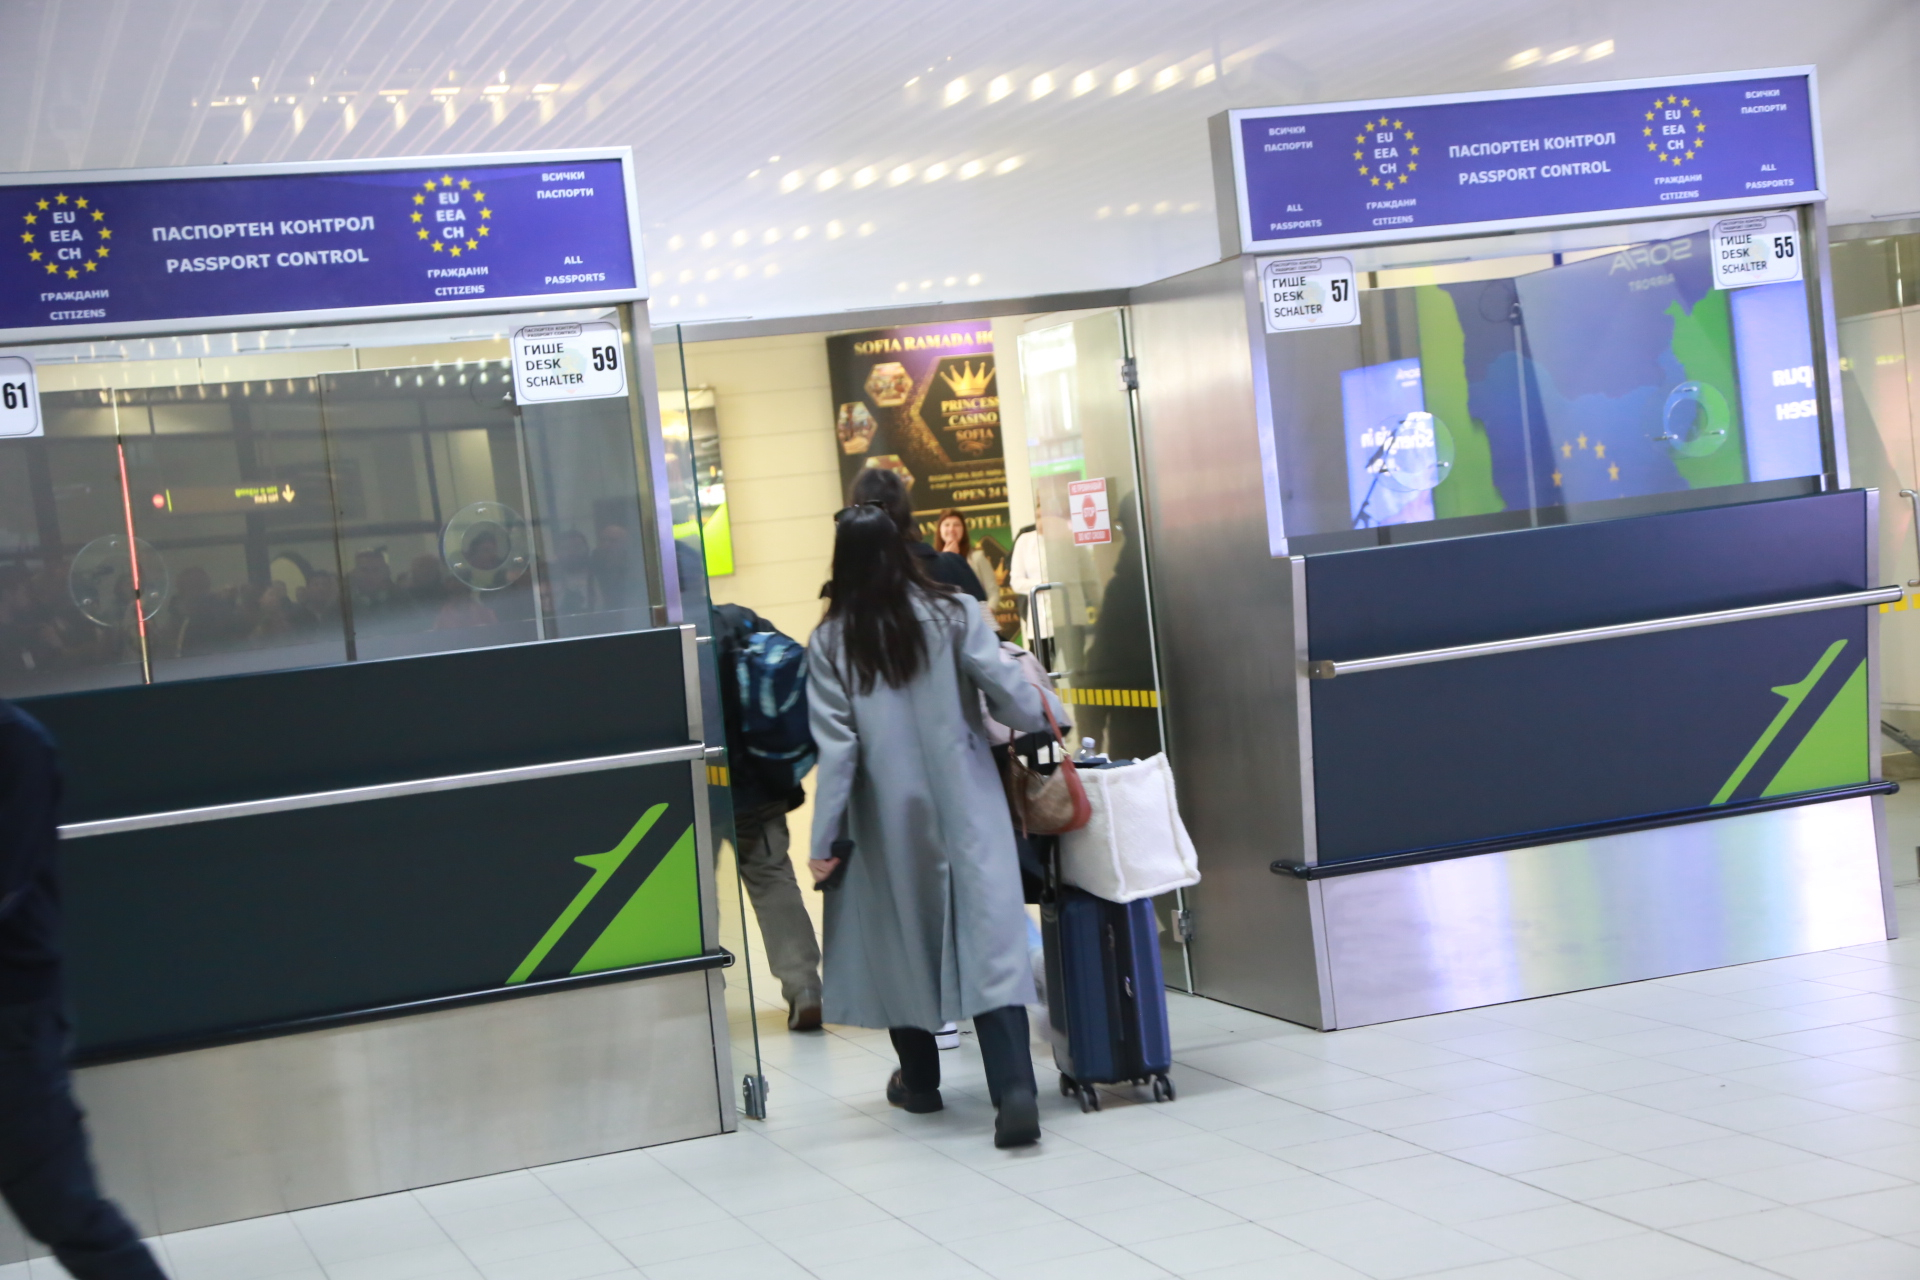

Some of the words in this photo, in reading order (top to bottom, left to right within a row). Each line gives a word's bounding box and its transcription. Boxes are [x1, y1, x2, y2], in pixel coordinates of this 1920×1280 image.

[1745, 89, 1780, 99] ВСИЧКИ
[1665, 110, 1681, 120] EU
[1741, 104, 1787, 114] ПАСПОРТИ
[1268, 126, 1306, 136] ВСИЧКИ
[1662, 124, 1686, 135] EEA
[1376, 132, 1394, 143] EU
[1264, 141, 1313, 152] ПАСПОРТИ
[1449, 138, 1540, 158] ПАСПОРТЕН
[1543, 132, 1616, 150] КОНТРОЛ
[1667, 139, 1685, 150] CH
[1374, 147, 1398, 159] EEA
[1379, 163, 1397, 174] CH
[1459, 166, 1537, 185] PASSPORT
[1540, 161, 1611, 178] CONTROL
[1761, 163, 1777, 172] ALL
[541, 171, 585, 182] ВСИЧКИ
[1654, 174, 1703, 185] ГРАЖДАНИ
[1745, 178, 1794, 189] PASSPORTS
[439, 192, 460, 204] EU
[537, 188, 594, 199] ПАСПОРТИ
[1660, 190, 1699, 200] CITIZENS
[1286, 204, 1303, 213] ALL
[1366, 198, 1417, 210] ГРАЖДАНИ
[53, 211, 76, 224] EU
[436, 209, 466, 222] EEA
[1372, 215, 1414, 226] CITIZENS
[152, 221, 274, 241] ПАСПОРТЕН
[280, 216, 375, 235] КОНТРОЛ
[1270, 219, 1322, 231] PASSPORTS
[50, 229, 83, 242] EEA
[442, 226, 464, 239] CH
[1720, 234, 1752, 246] ГИШЕ
[1774, 236, 1794, 259] 55
[57, 248, 82, 261] CH
[1722, 248, 1750, 260] DESK
[166, 253, 271, 273] PASSPORT
[277, 248, 369, 267] CONTROL
[564, 256, 583, 265] ALL
[427, 266, 489, 279] ГРАЖДАНИ
[1722, 261, 1768, 275] SCHALTER
[545, 273, 606, 285] PASSPORTS
[1273, 276, 1306, 288] ГИШЕ
[41, 289, 109, 302] ГРАЖДАНИ
[435, 285, 485, 297] CITIZENS
[1331, 278, 1349, 302] 57
[1274, 291, 1304, 303] DESK
[50, 308, 106, 321] CITIZENS
[1274, 304, 1323, 318] SCHALTER
[524, 343, 564, 355] ГИШЕ
[854, 338, 902, 355] SOFIA
[904, 333, 974, 351] RAMADA
[592, 345, 618, 371] 59
[525, 358, 562, 371] DESK
[526, 373, 584, 388] SCHALTER
[2, 381, 29, 410] 61
[948, 411, 998, 427] CASINO
[956, 428, 994, 441] SOFIA
